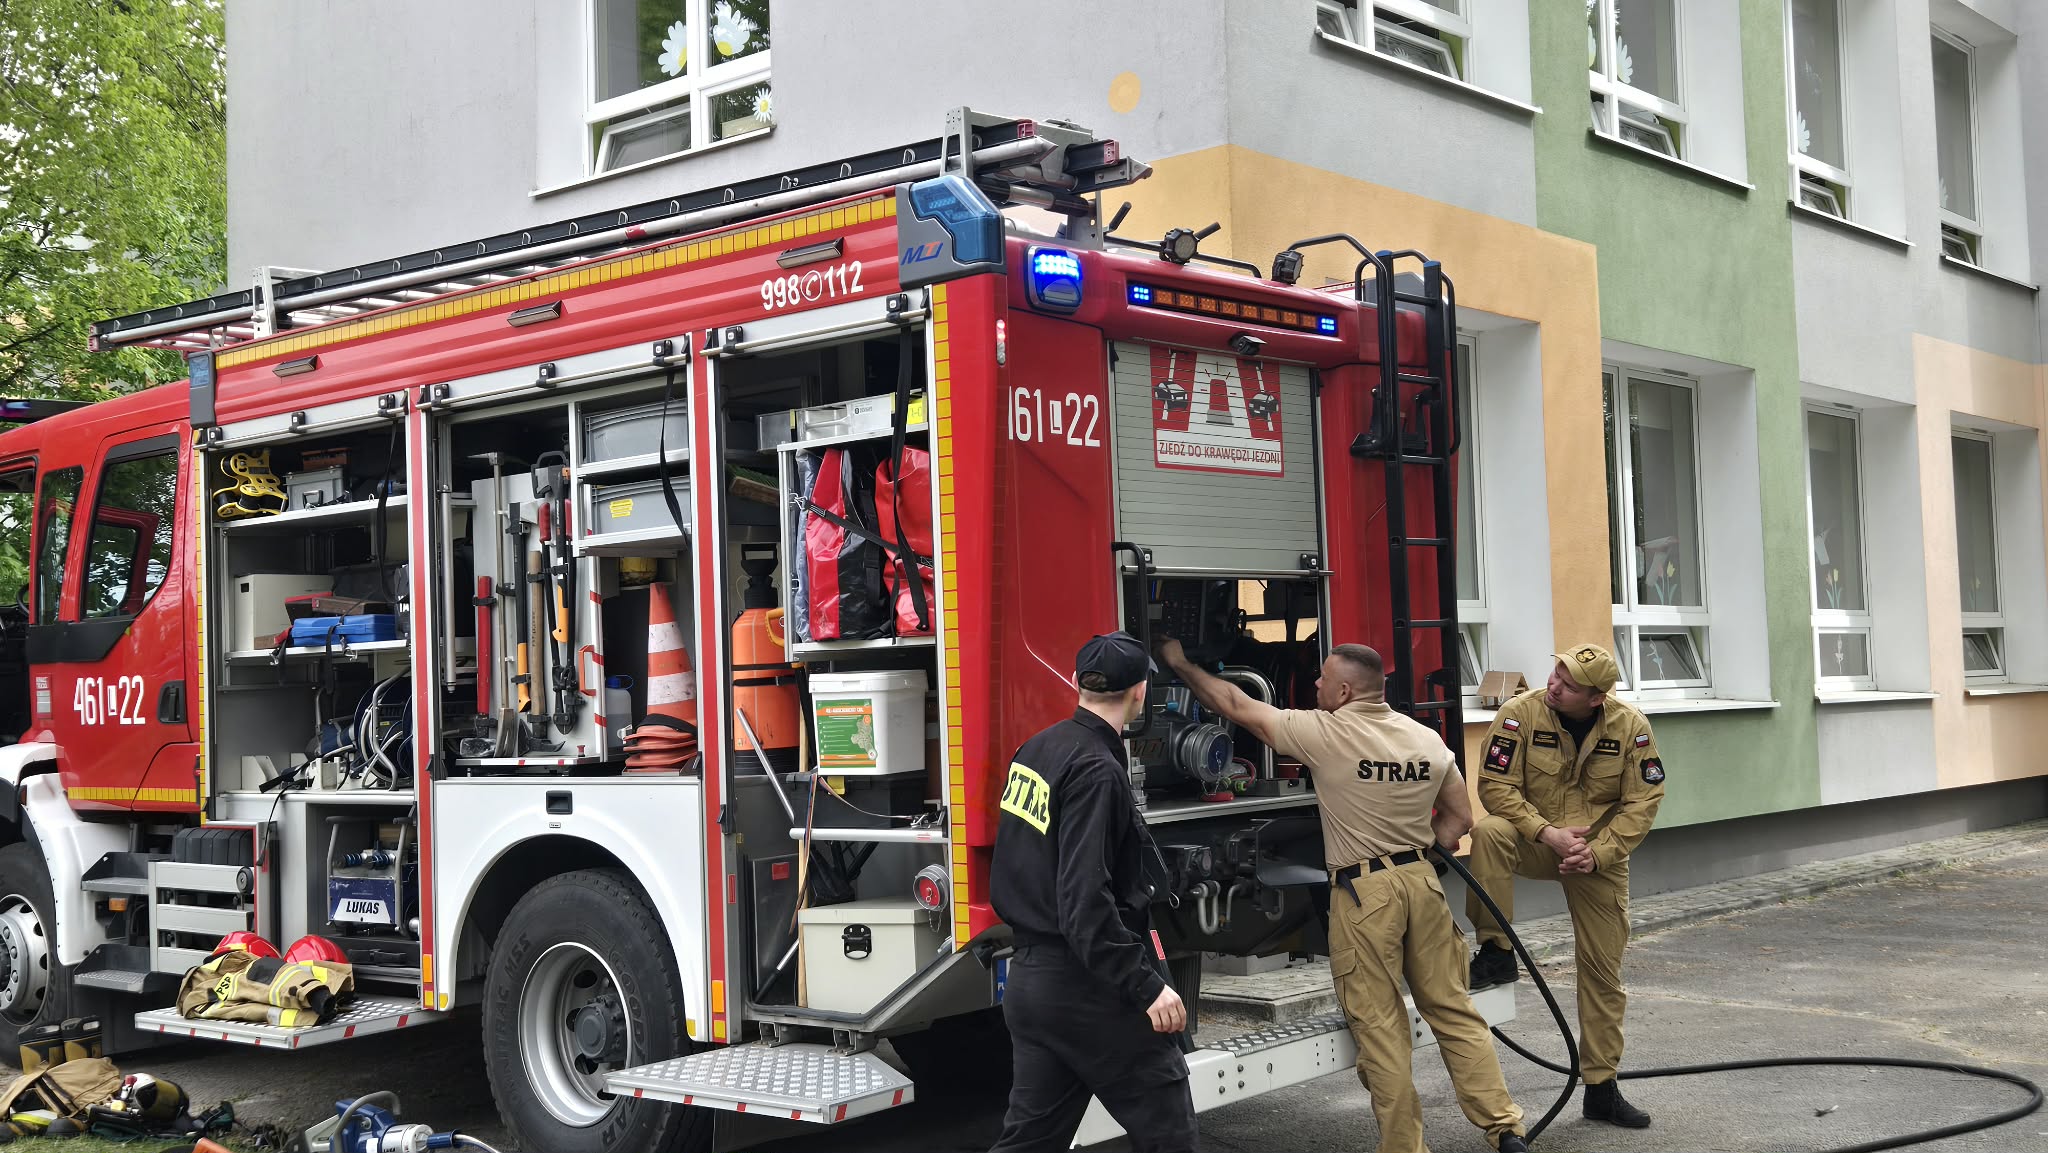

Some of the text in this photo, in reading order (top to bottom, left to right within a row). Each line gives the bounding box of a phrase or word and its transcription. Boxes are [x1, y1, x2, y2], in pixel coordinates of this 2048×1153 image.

[760, 260, 864, 311] 998 112
[1065, 392, 1101, 447] 22
[1159, 441, 1281, 465] ZJEDŹ DO KRAWĘDZI JEZDNI
[73, 676, 105, 726] 461
[118, 675, 146, 725] 22
[345, 900, 380, 914] LUKAS
[216, 976, 232, 995] PSP
